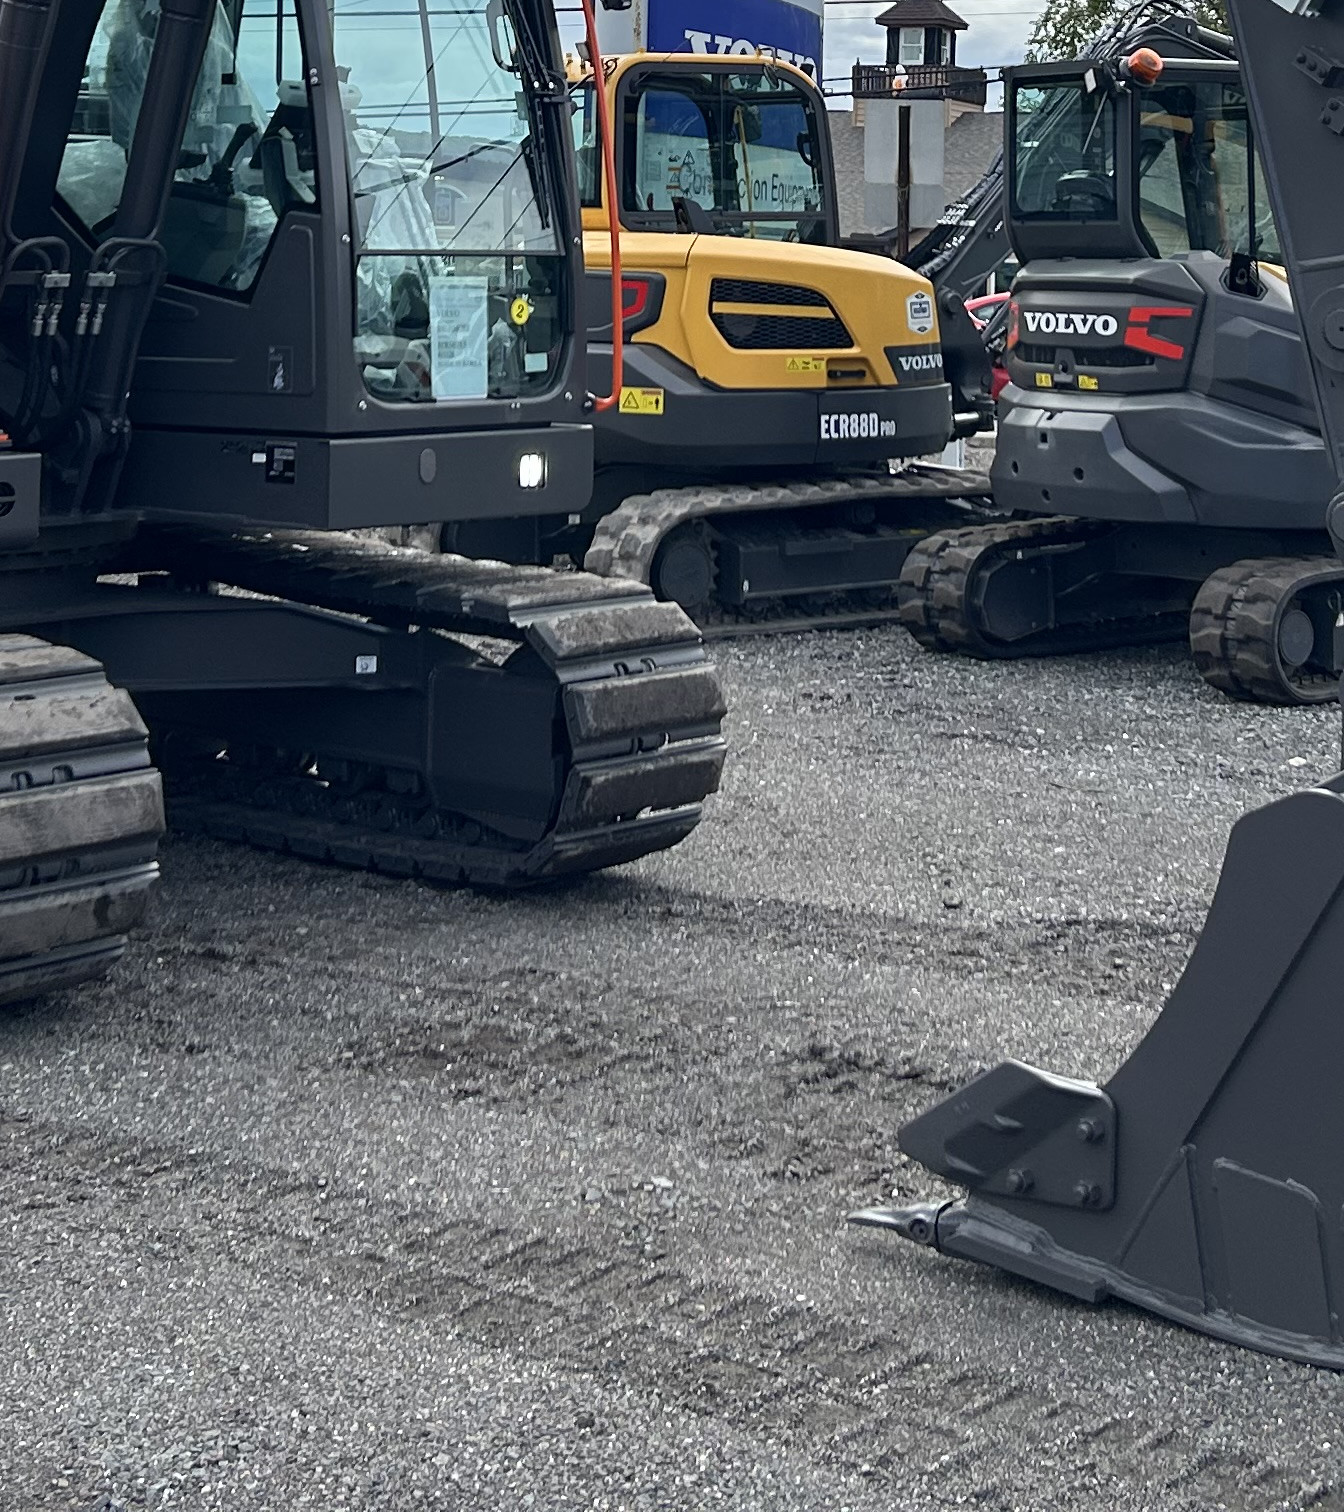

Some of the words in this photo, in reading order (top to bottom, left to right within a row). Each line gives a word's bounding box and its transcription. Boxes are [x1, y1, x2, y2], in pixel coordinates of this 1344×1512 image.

[516, 304, 525, 318] 2
[1023, 311, 1118, 336] VOLVO
[898, 353, 943, 371] VOLVO
[820, 413, 879, 439] ECR88D
[880, 420, 896, 436] PRO
